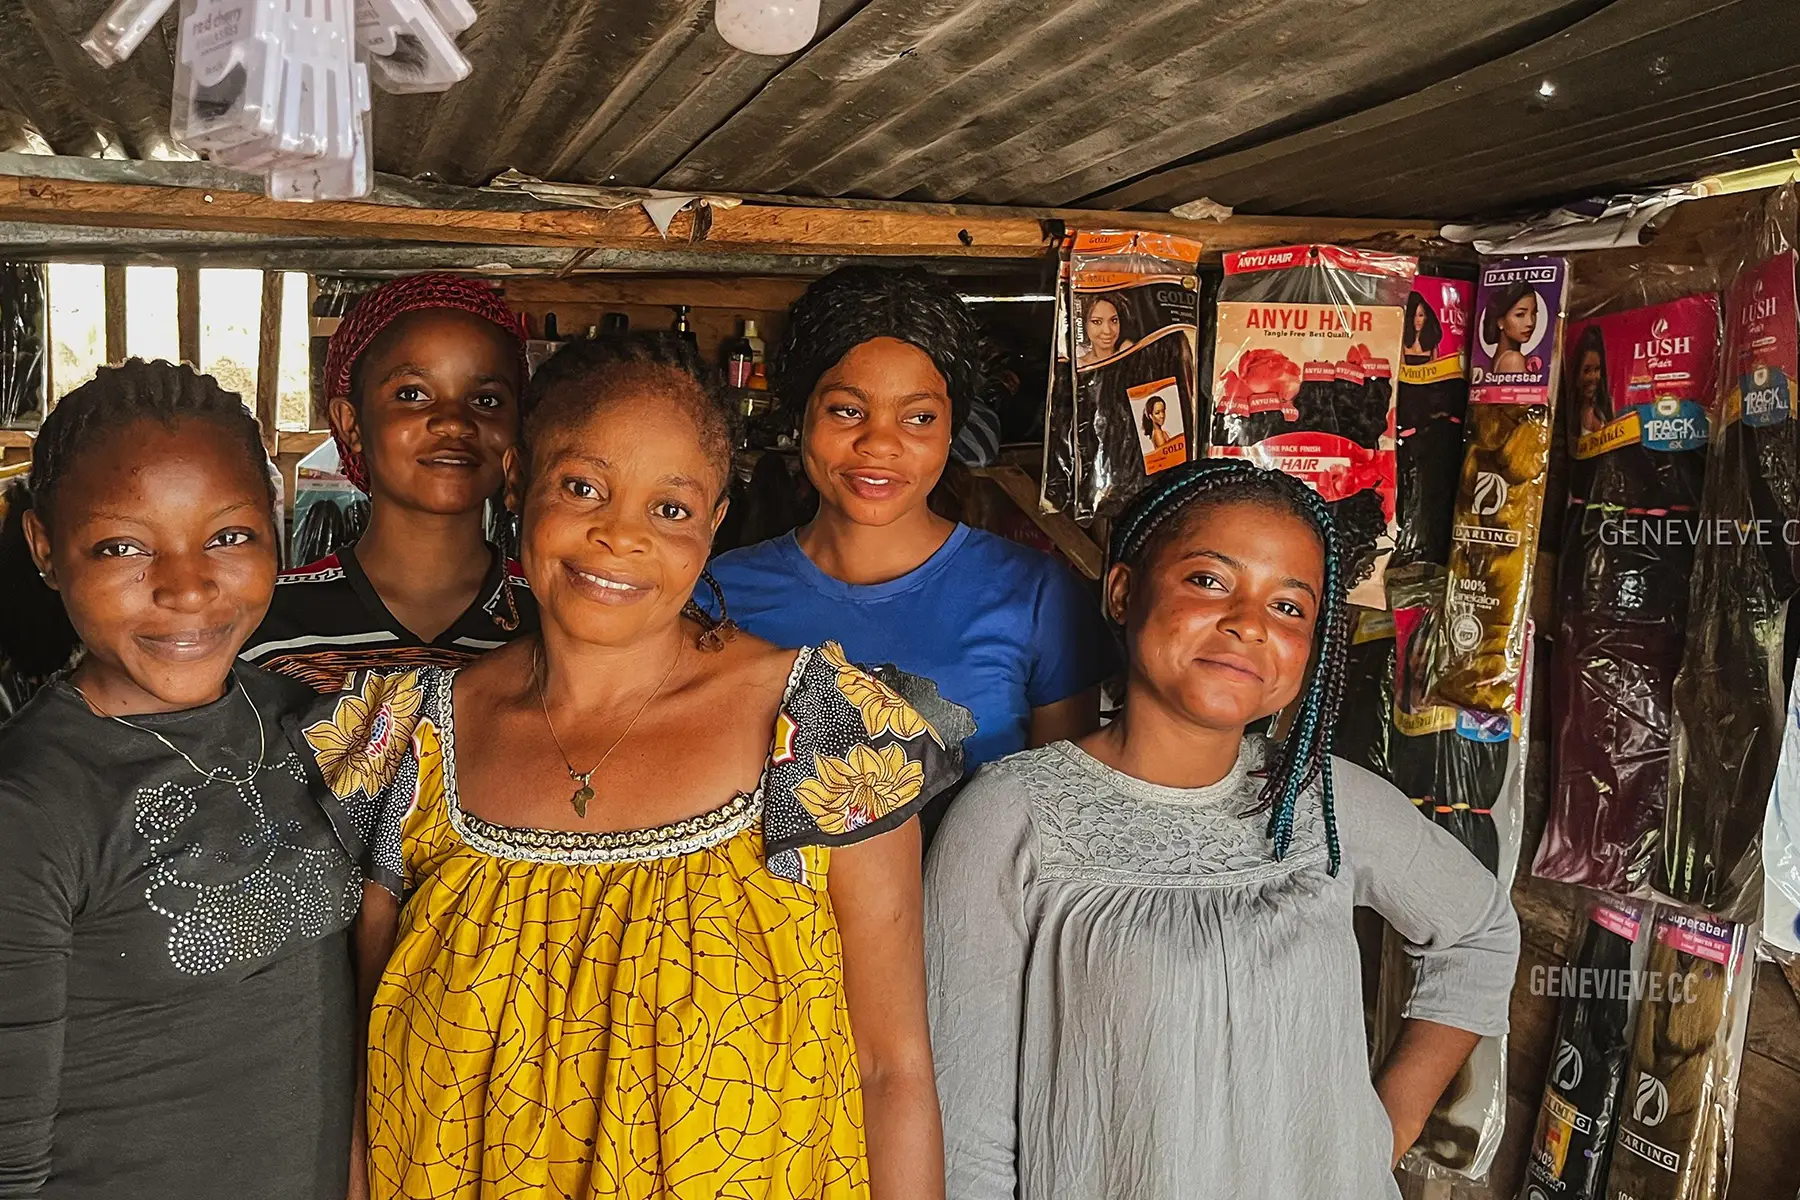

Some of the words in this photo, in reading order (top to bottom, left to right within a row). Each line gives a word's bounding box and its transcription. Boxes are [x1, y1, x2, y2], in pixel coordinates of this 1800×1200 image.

[1238, 255, 1266, 268] ANYU
[1267, 252, 1293, 265] HAIR
[1488, 269, 1551, 283] DARLING
[1157, 290, 1196, 305] GOLD
[1440, 308, 1465, 325] LUS
[1742, 297, 1777, 325] LUSH
[1246, 308, 1308, 329] ANYU
[1319, 310, 1373, 331] HAIR
[1264, 330, 1288, 338] Tangle
[1327, 331, 1354, 340] Quality
[1633, 336, 1691, 360] LUSH
[1648, 357, 1672, 369] Hair
[1485, 372, 1543, 385] Superstar
[1751, 387, 1781, 406] PACK
[1654, 418, 1694, 432] PACK
[1654, 431, 1678, 440] DOES
[1679, 431, 1688, 439] IT
[1690, 430, 1707, 439] ALL
[1162, 442, 1184, 455] GOLD
[1280, 458, 1320, 470] HAIR
[1455, 528, 1516, 543] DARLING
[1460, 578, 1487, 592] 100%
[1454, 592, 1500, 606] anekalon
[1619, 1129, 1674, 1166] DARLING
